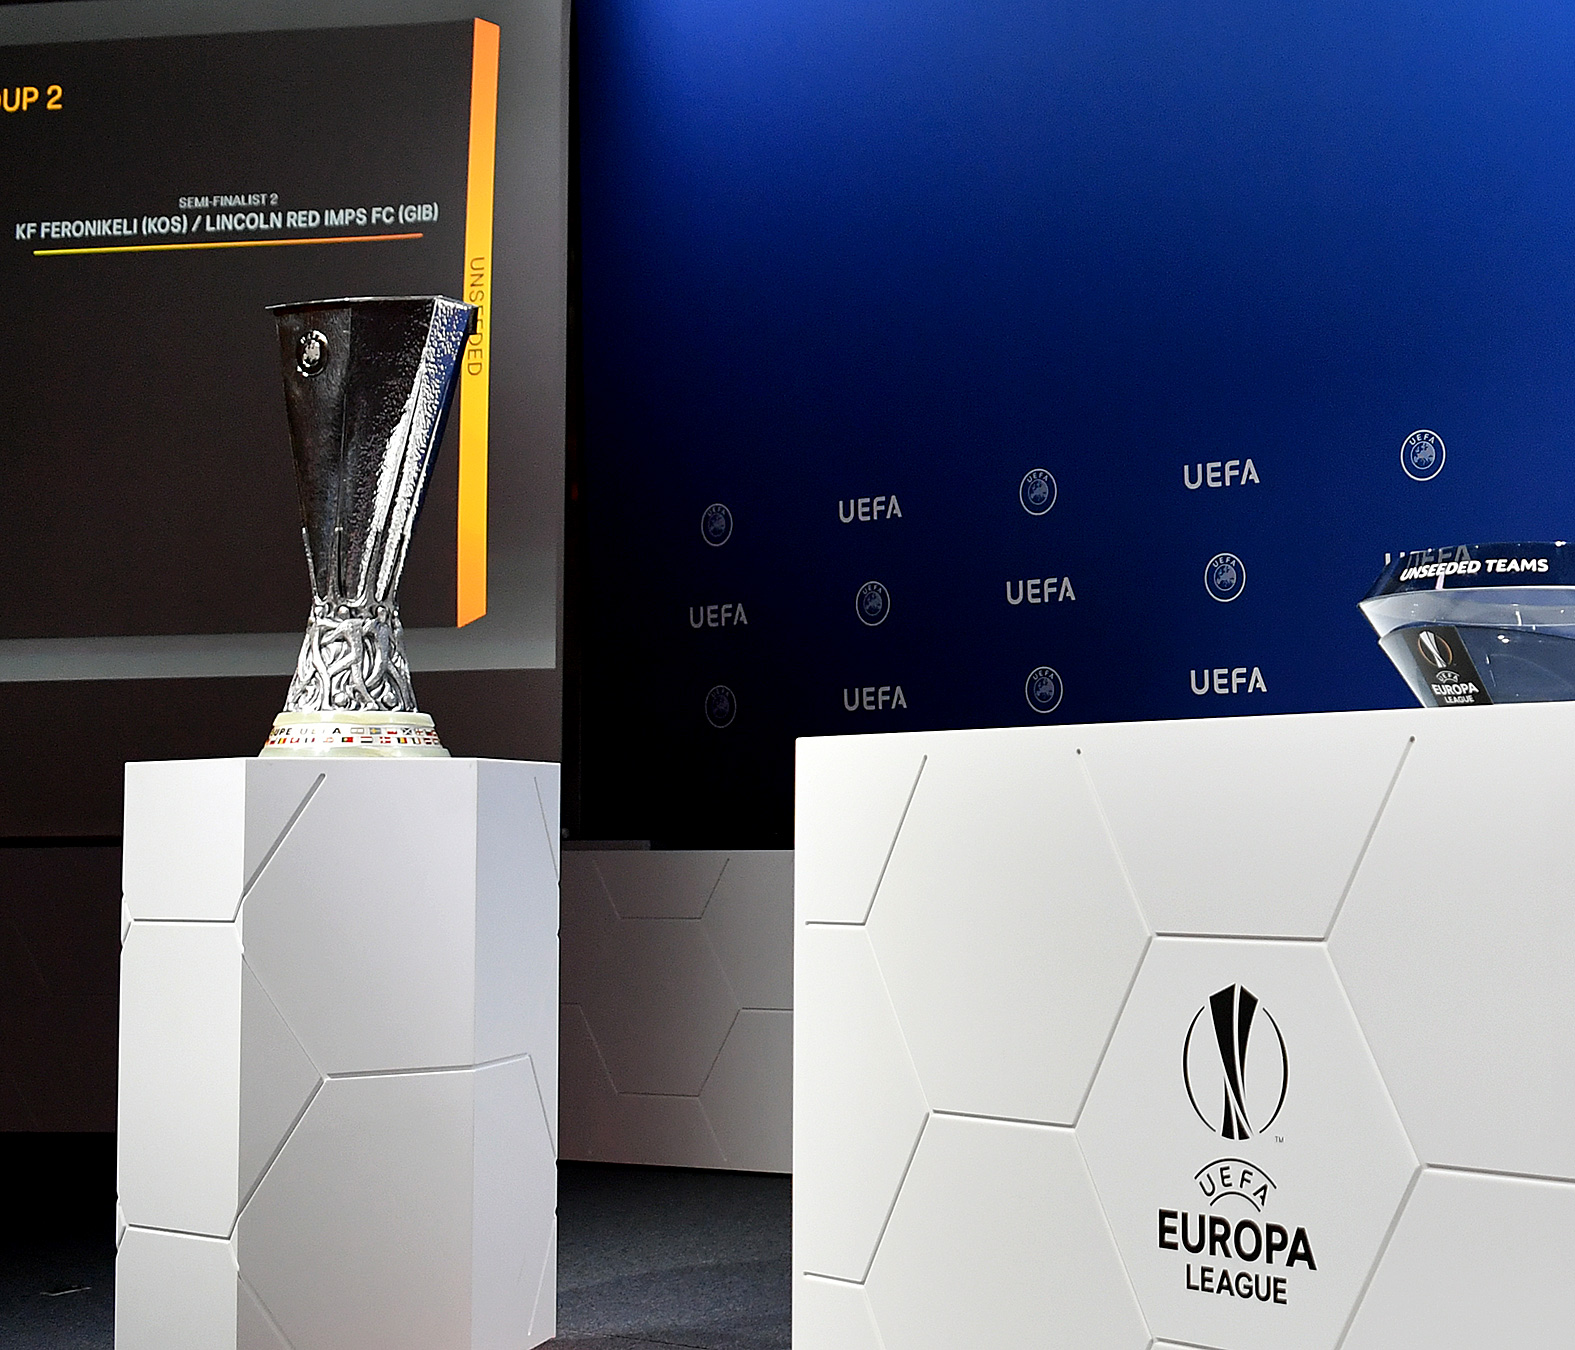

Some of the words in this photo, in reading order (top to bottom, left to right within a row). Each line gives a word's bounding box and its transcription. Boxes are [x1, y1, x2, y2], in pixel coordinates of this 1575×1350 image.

[0, 86, 39, 112] UP
[46, 84, 63, 110] 2
[179, 194, 268, 209] SEMI-FINALIST
[269, 193, 279, 205] 2
[15, 223, 37, 240] KF
[40, 218, 138, 239] FERONIKELI
[142, 214, 188, 235] (KOS)
[191, 215, 202, 232] /
[205, 212, 283, 231] LINCOLN
[286, 210, 321, 228] RED
[324, 207, 367, 227] IMPS
[371, 206, 395, 224] FC
[398, 202, 439, 224] (GIB)
[1409, 433, 1435, 445] UEFA
[1026, 472, 1048, 482] UEFA
[1183, 458, 1260, 490] UEFA
[838, 494, 902, 523] UEFA
[1212, 557, 1236, 567] UEFA
[1400, 560, 1482, 581] UNSEEDED
[1485, 559, 1549, 572] TEAMS
[862, 585, 881, 594] UEFA
[1006, 576, 1076, 605] UEFA
[689, 602, 748, 629] UEFA
[1033, 670, 1054, 680] UEFA
[1190, 666, 1268, 695] UEFA
[1438, 672, 1459, 682] UEFA
[843, 685, 908, 711] UEFA
[1431, 682, 1479, 695] EUROPA
[1444, 695, 1475, 703] LEAGUE
[1199, 1165, 1268, 1206] UEFA
[1158, 1208, 1317, 1271] EUROPA
[1186, 1263, 1288, 1305] LEAGUE
